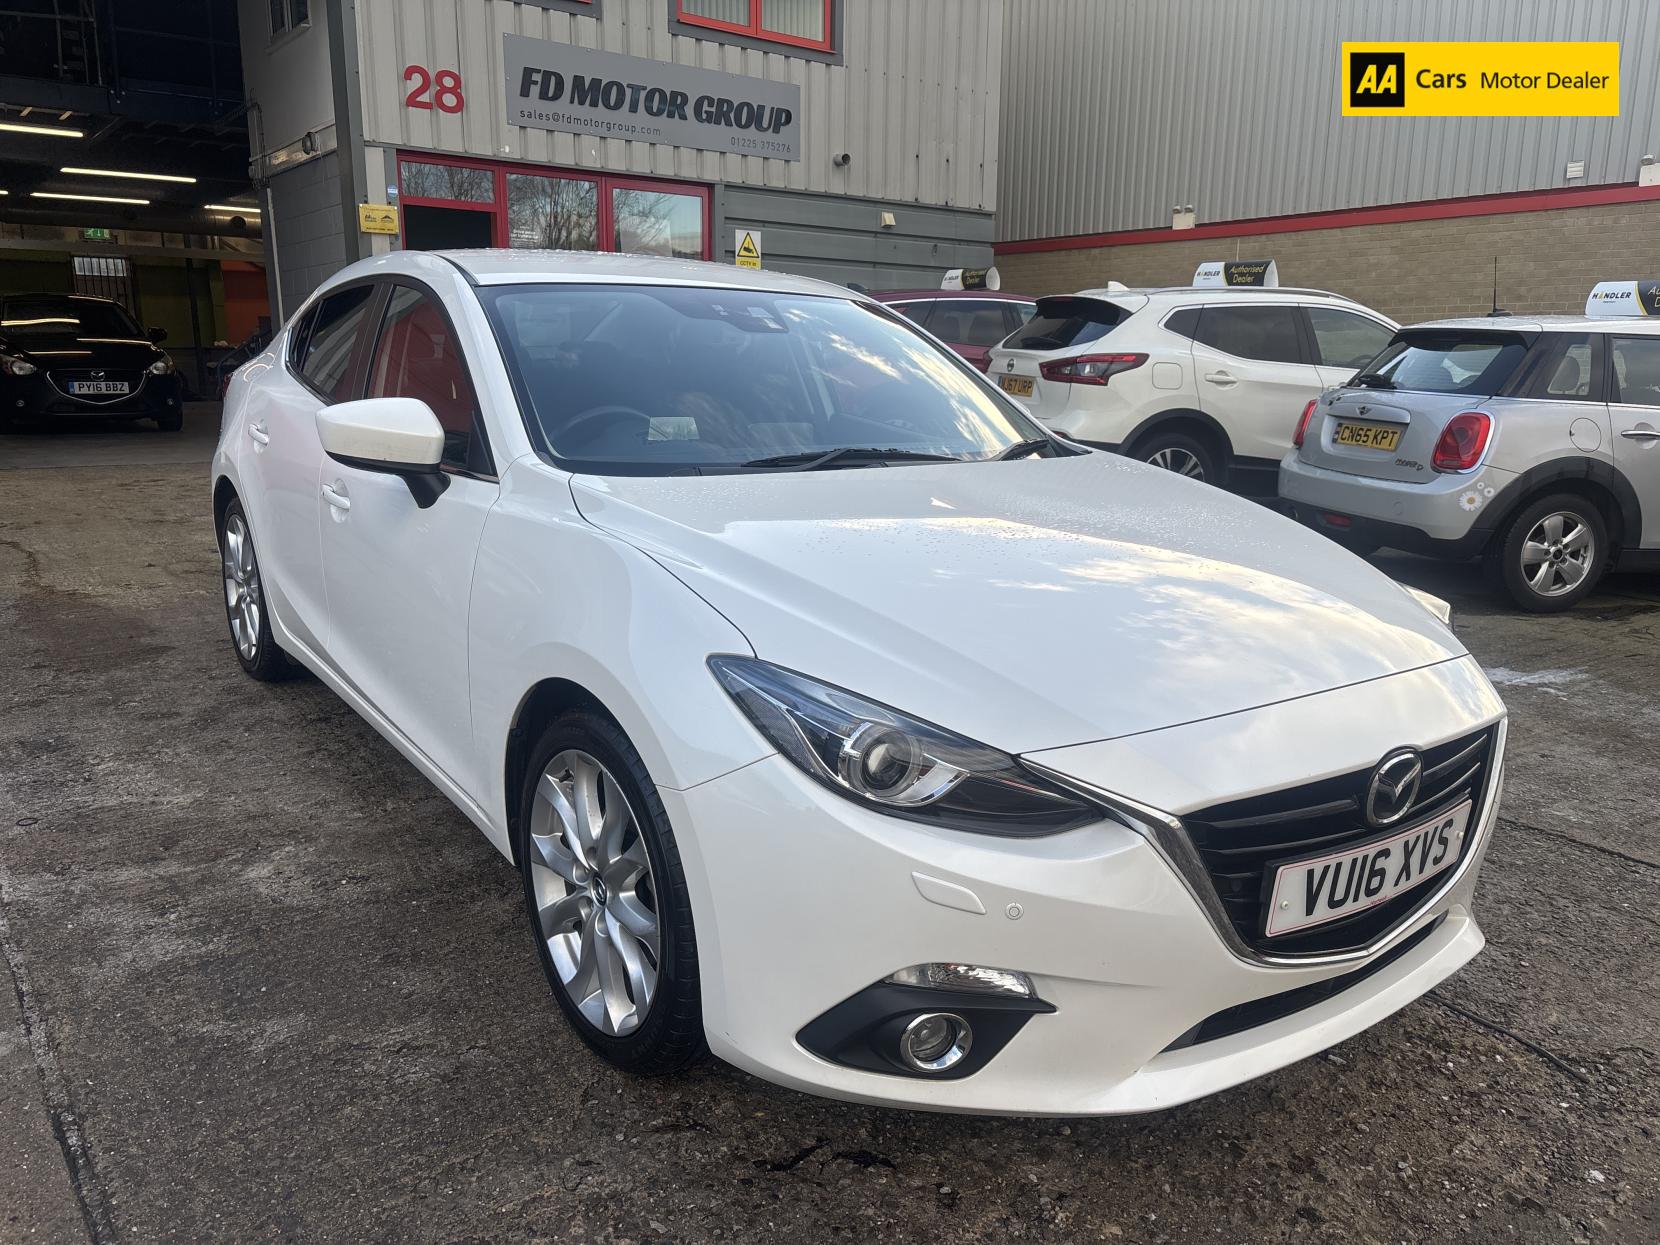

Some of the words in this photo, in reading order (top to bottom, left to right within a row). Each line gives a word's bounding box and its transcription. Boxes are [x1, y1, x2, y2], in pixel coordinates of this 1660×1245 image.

[403, 65, 464, 113] 28
[519, 66, 565, 102] FD
[569, 74, 689, 121] MOTOR
[693, 95, 792, 134] GROUP
[519, 109, 661, 136] sales@fdmotorgroup.com
[730, 136, 757, 149] 01225
[760, 140, 791, 153] 375276
[1229, 264, 1265, 273] Authorised
[1232, 274, 1255, 283] Dealer
[1592, 291, 1631, 299] HANDLER
[77, 382, 102, 392] PY16
[105, 382, 125, 392] BBZ
[1340, 426, 1372, 443] CN65
[1371, 430, 1398, 447] KPT
[1305, 848, 1391, 917] VU16
[1393, 818, 1454, 888] XVS
